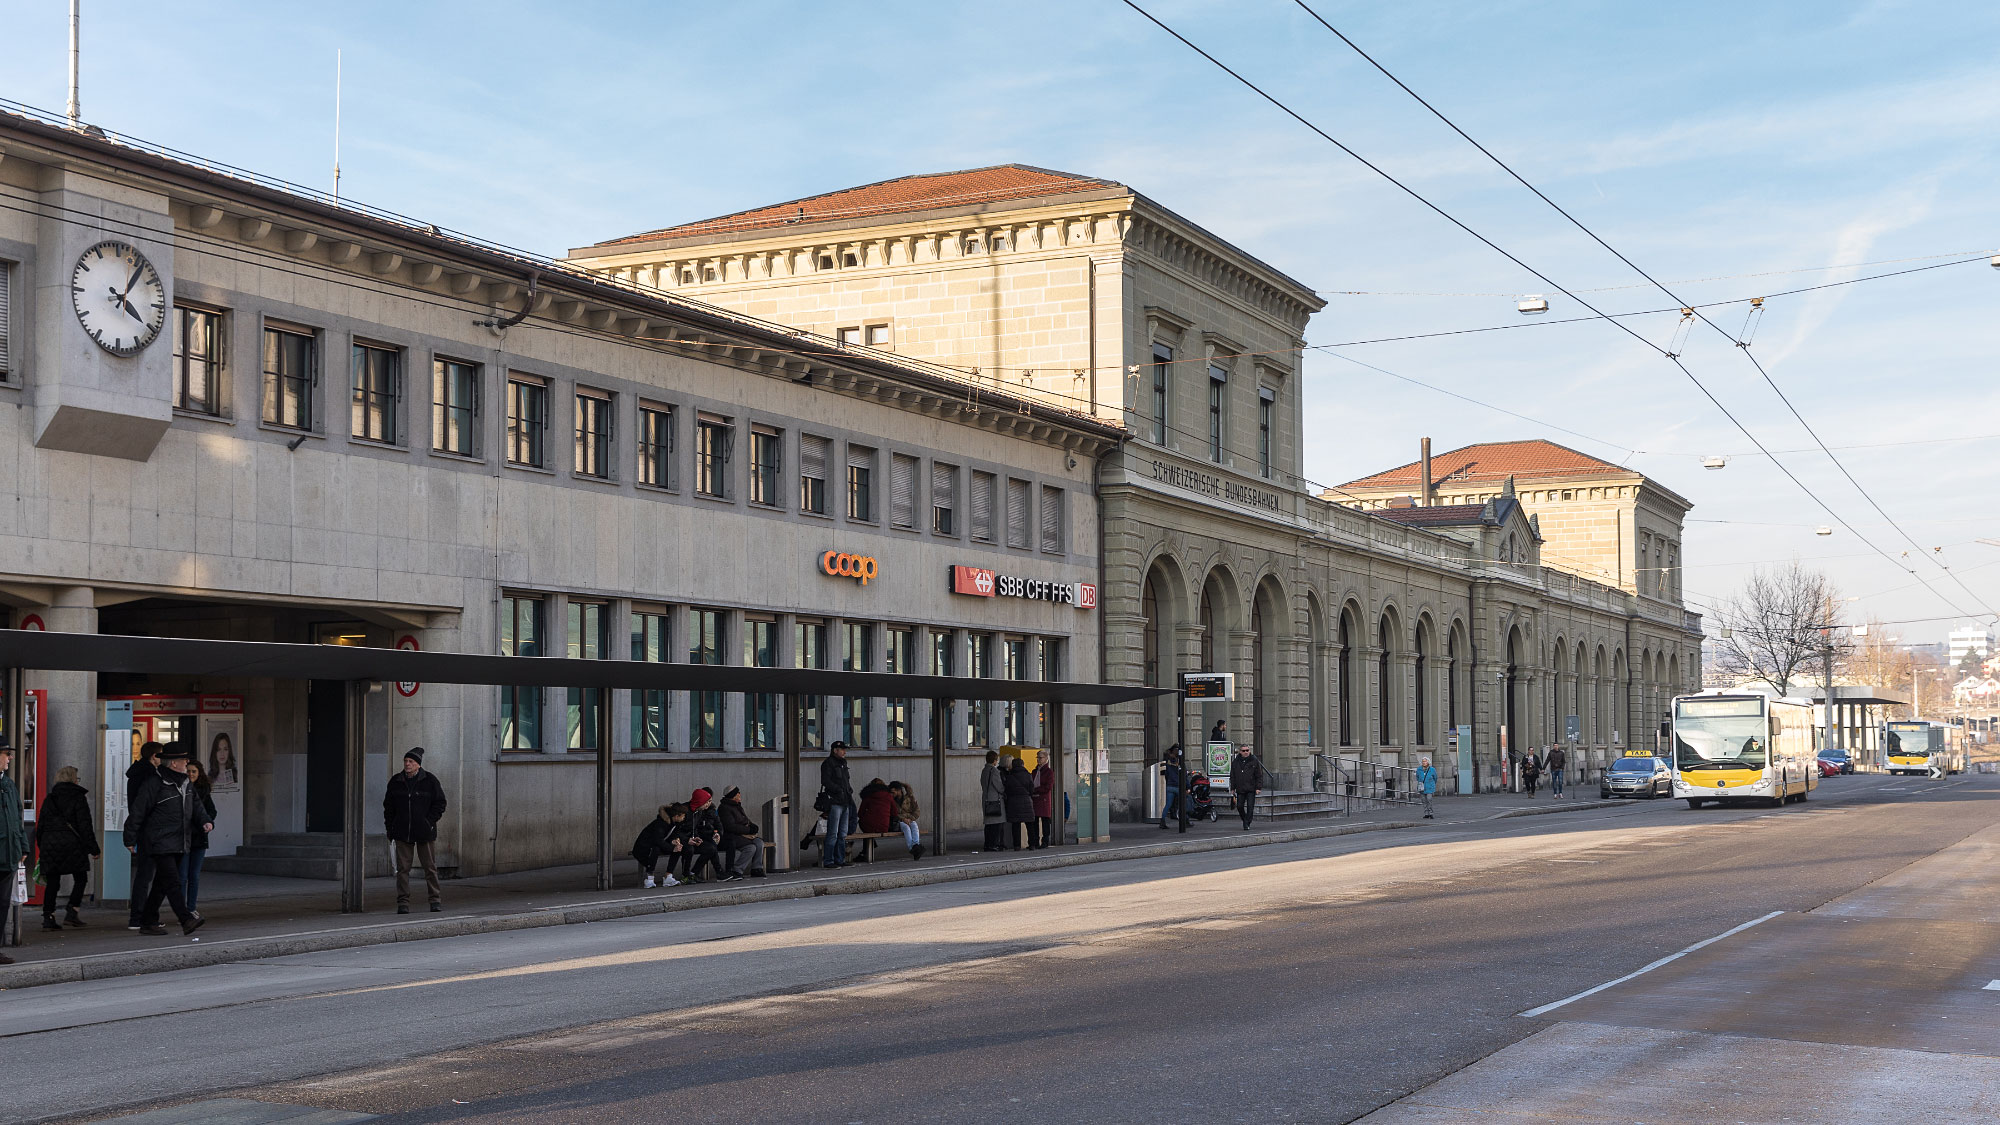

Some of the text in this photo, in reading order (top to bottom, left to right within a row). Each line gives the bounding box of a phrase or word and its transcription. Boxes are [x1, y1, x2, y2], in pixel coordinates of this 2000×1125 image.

[1152, 460, 1280, 513] SCHWEIZERISCHE BUNDESBAHNEN
[823, 550, 878, 585] coop
[999, 575, 1073, 604] SBB CFF FFS
[1082, 587, 1095, 605] DB
